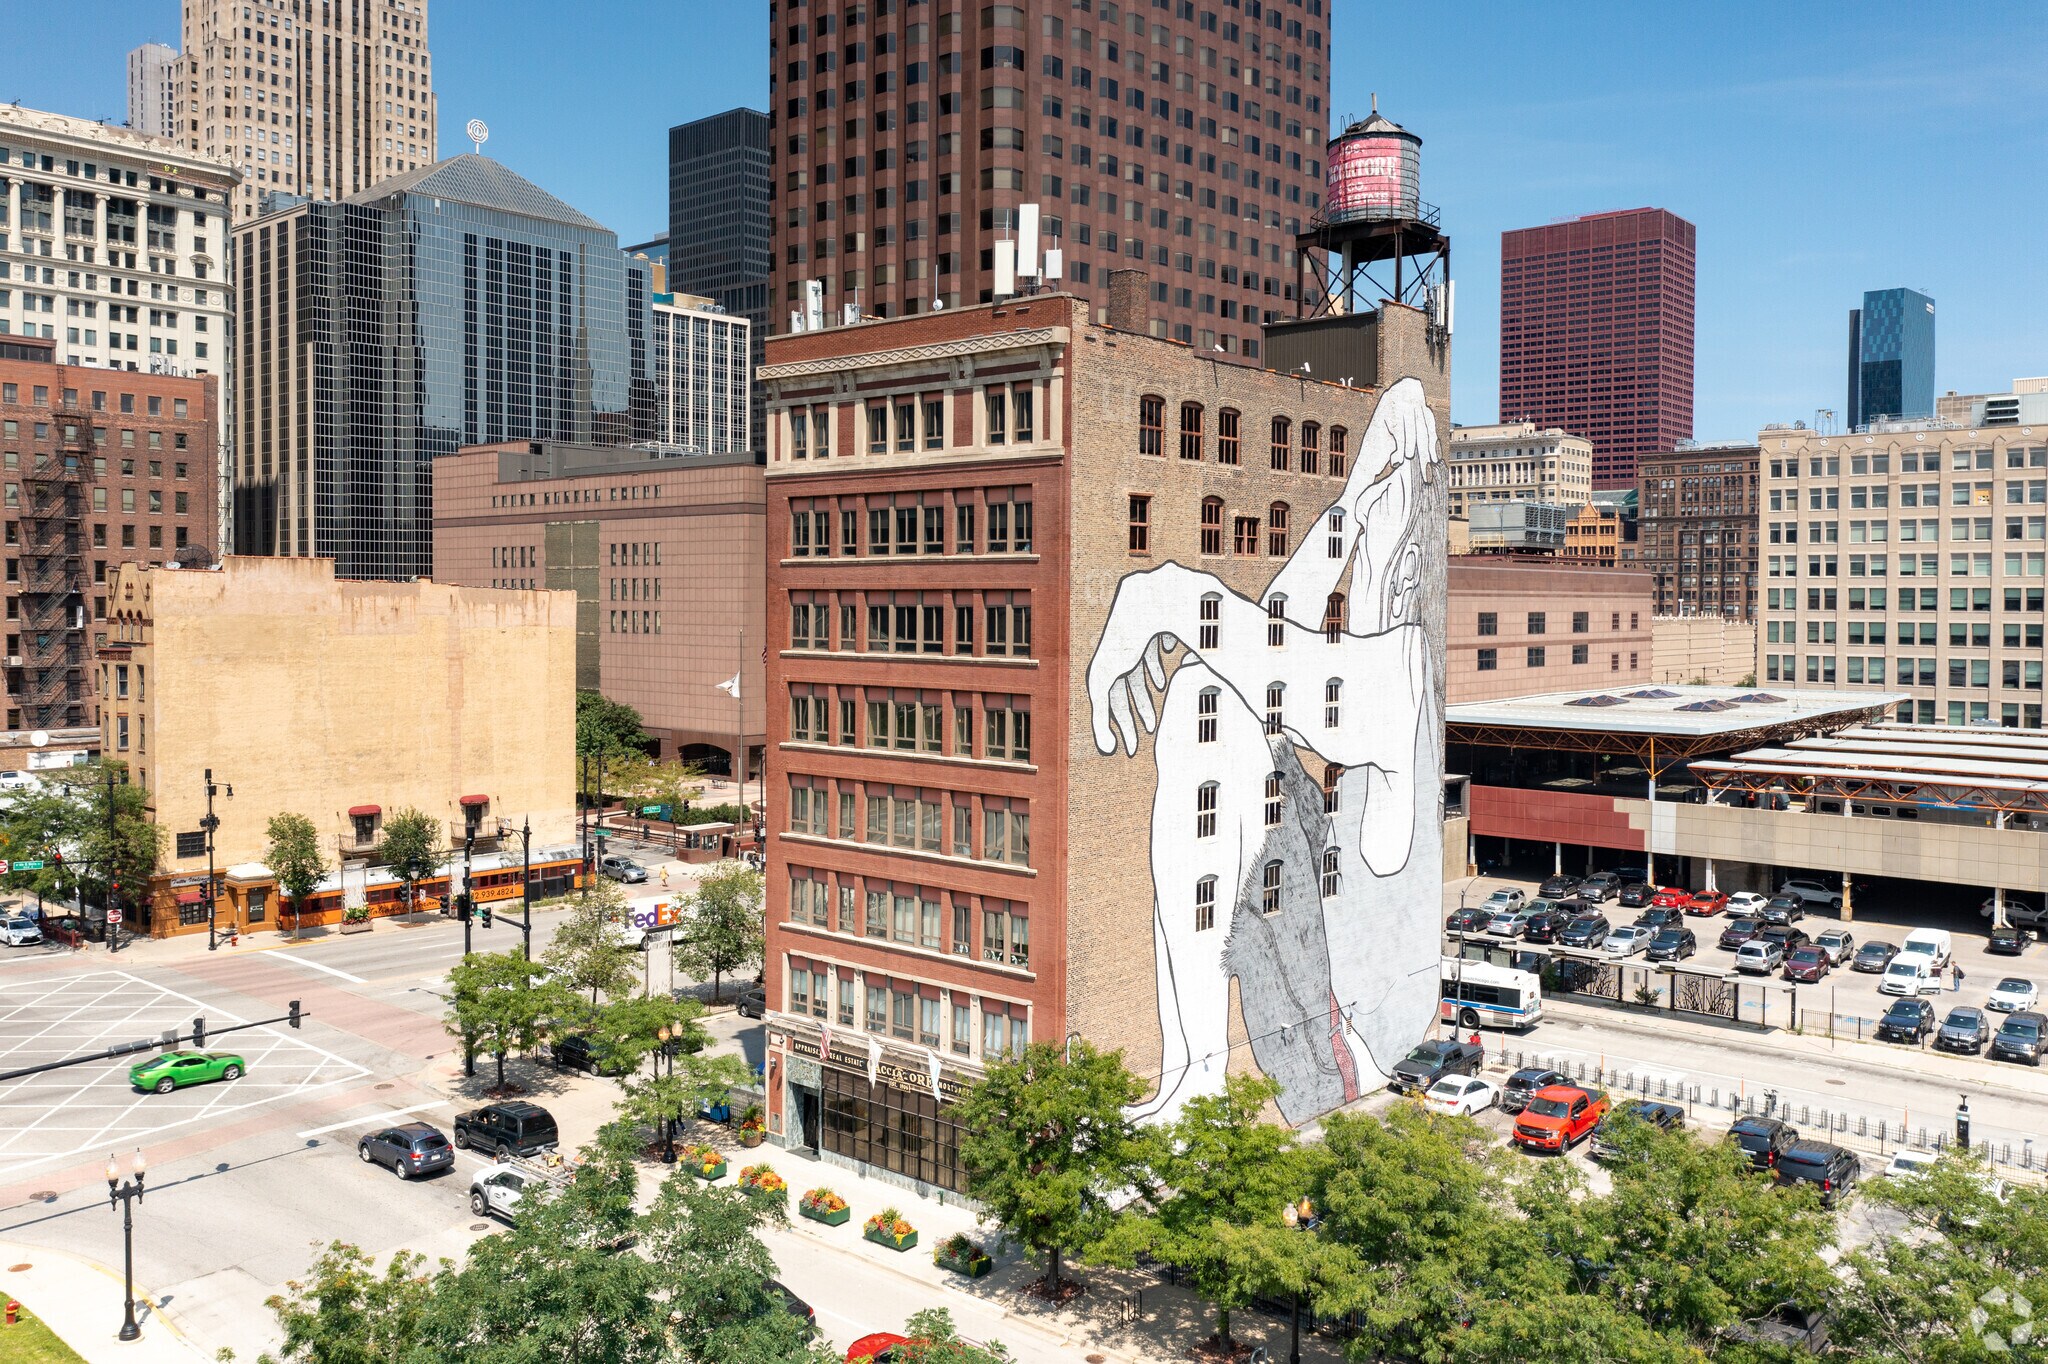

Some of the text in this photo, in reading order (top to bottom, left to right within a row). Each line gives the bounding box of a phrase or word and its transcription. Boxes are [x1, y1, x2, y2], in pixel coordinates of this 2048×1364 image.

[1347, 192, 1388, 204] ESTATE
[472, 887, 514, 901] 2.939.4824
[624, 903, 682, 929] FedEx
[844, 1056, 863, 1067] ESTATE
